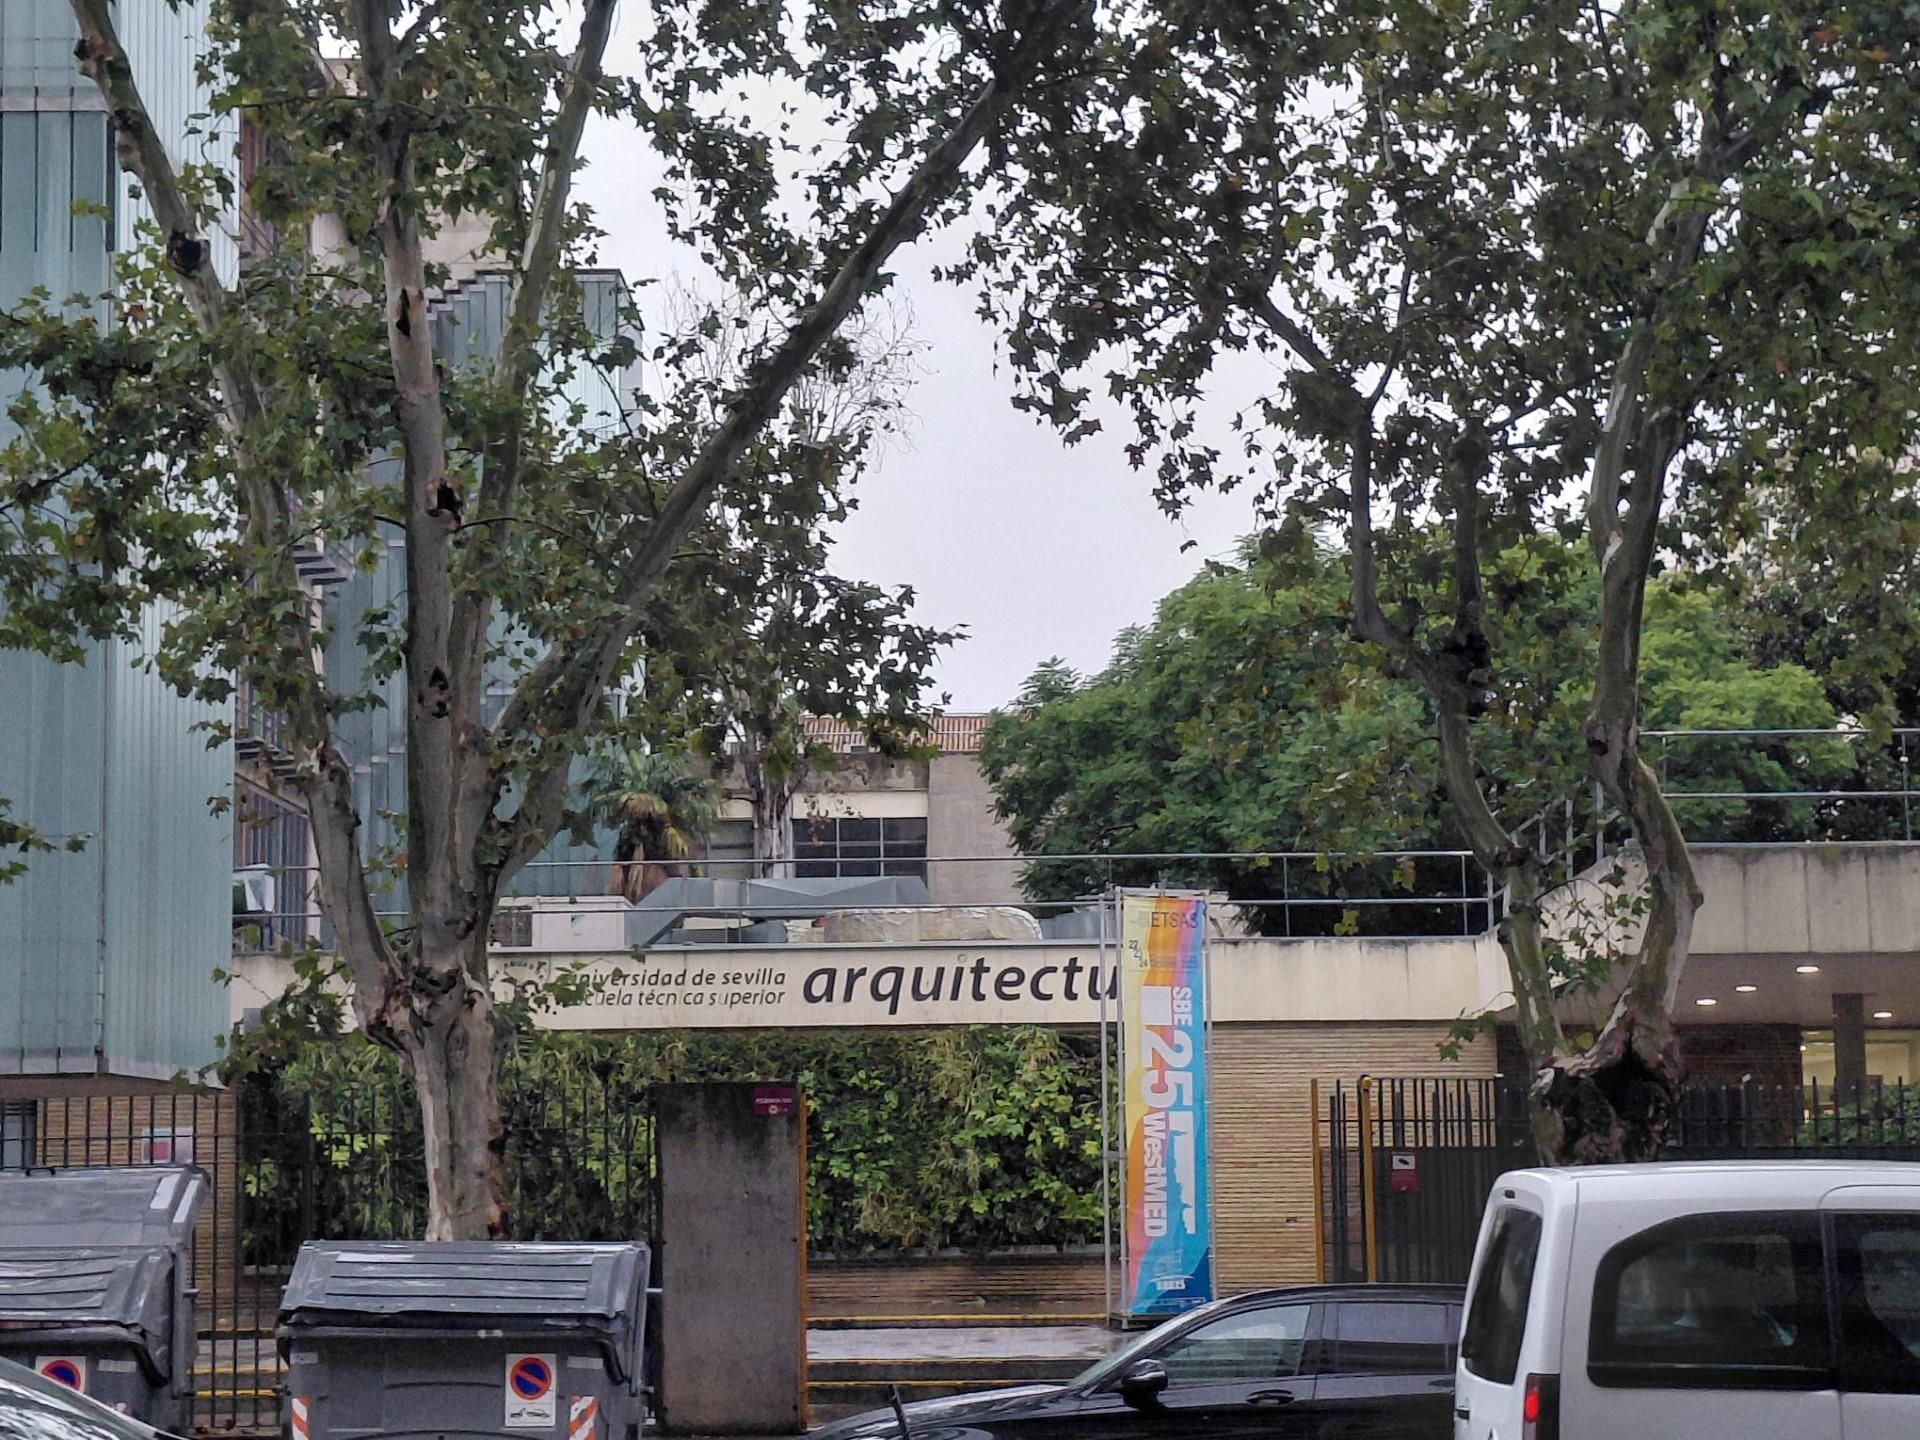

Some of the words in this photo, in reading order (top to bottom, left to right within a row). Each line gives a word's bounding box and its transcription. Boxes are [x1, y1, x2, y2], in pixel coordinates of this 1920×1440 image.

[1151, 911, 1198, 928] ETSAS
[691, 968, 716, 986] de
[721, 967, 786, 986] sevilla
[576, 988, 633, 1007] cuela
[638, 988, 704, 1007] técnca
[1173, 985, 1193, 1027] SBE
[1140, 1027, 1193, 1110] 25
[1143, 1111, 1168, 1238] WestMED
